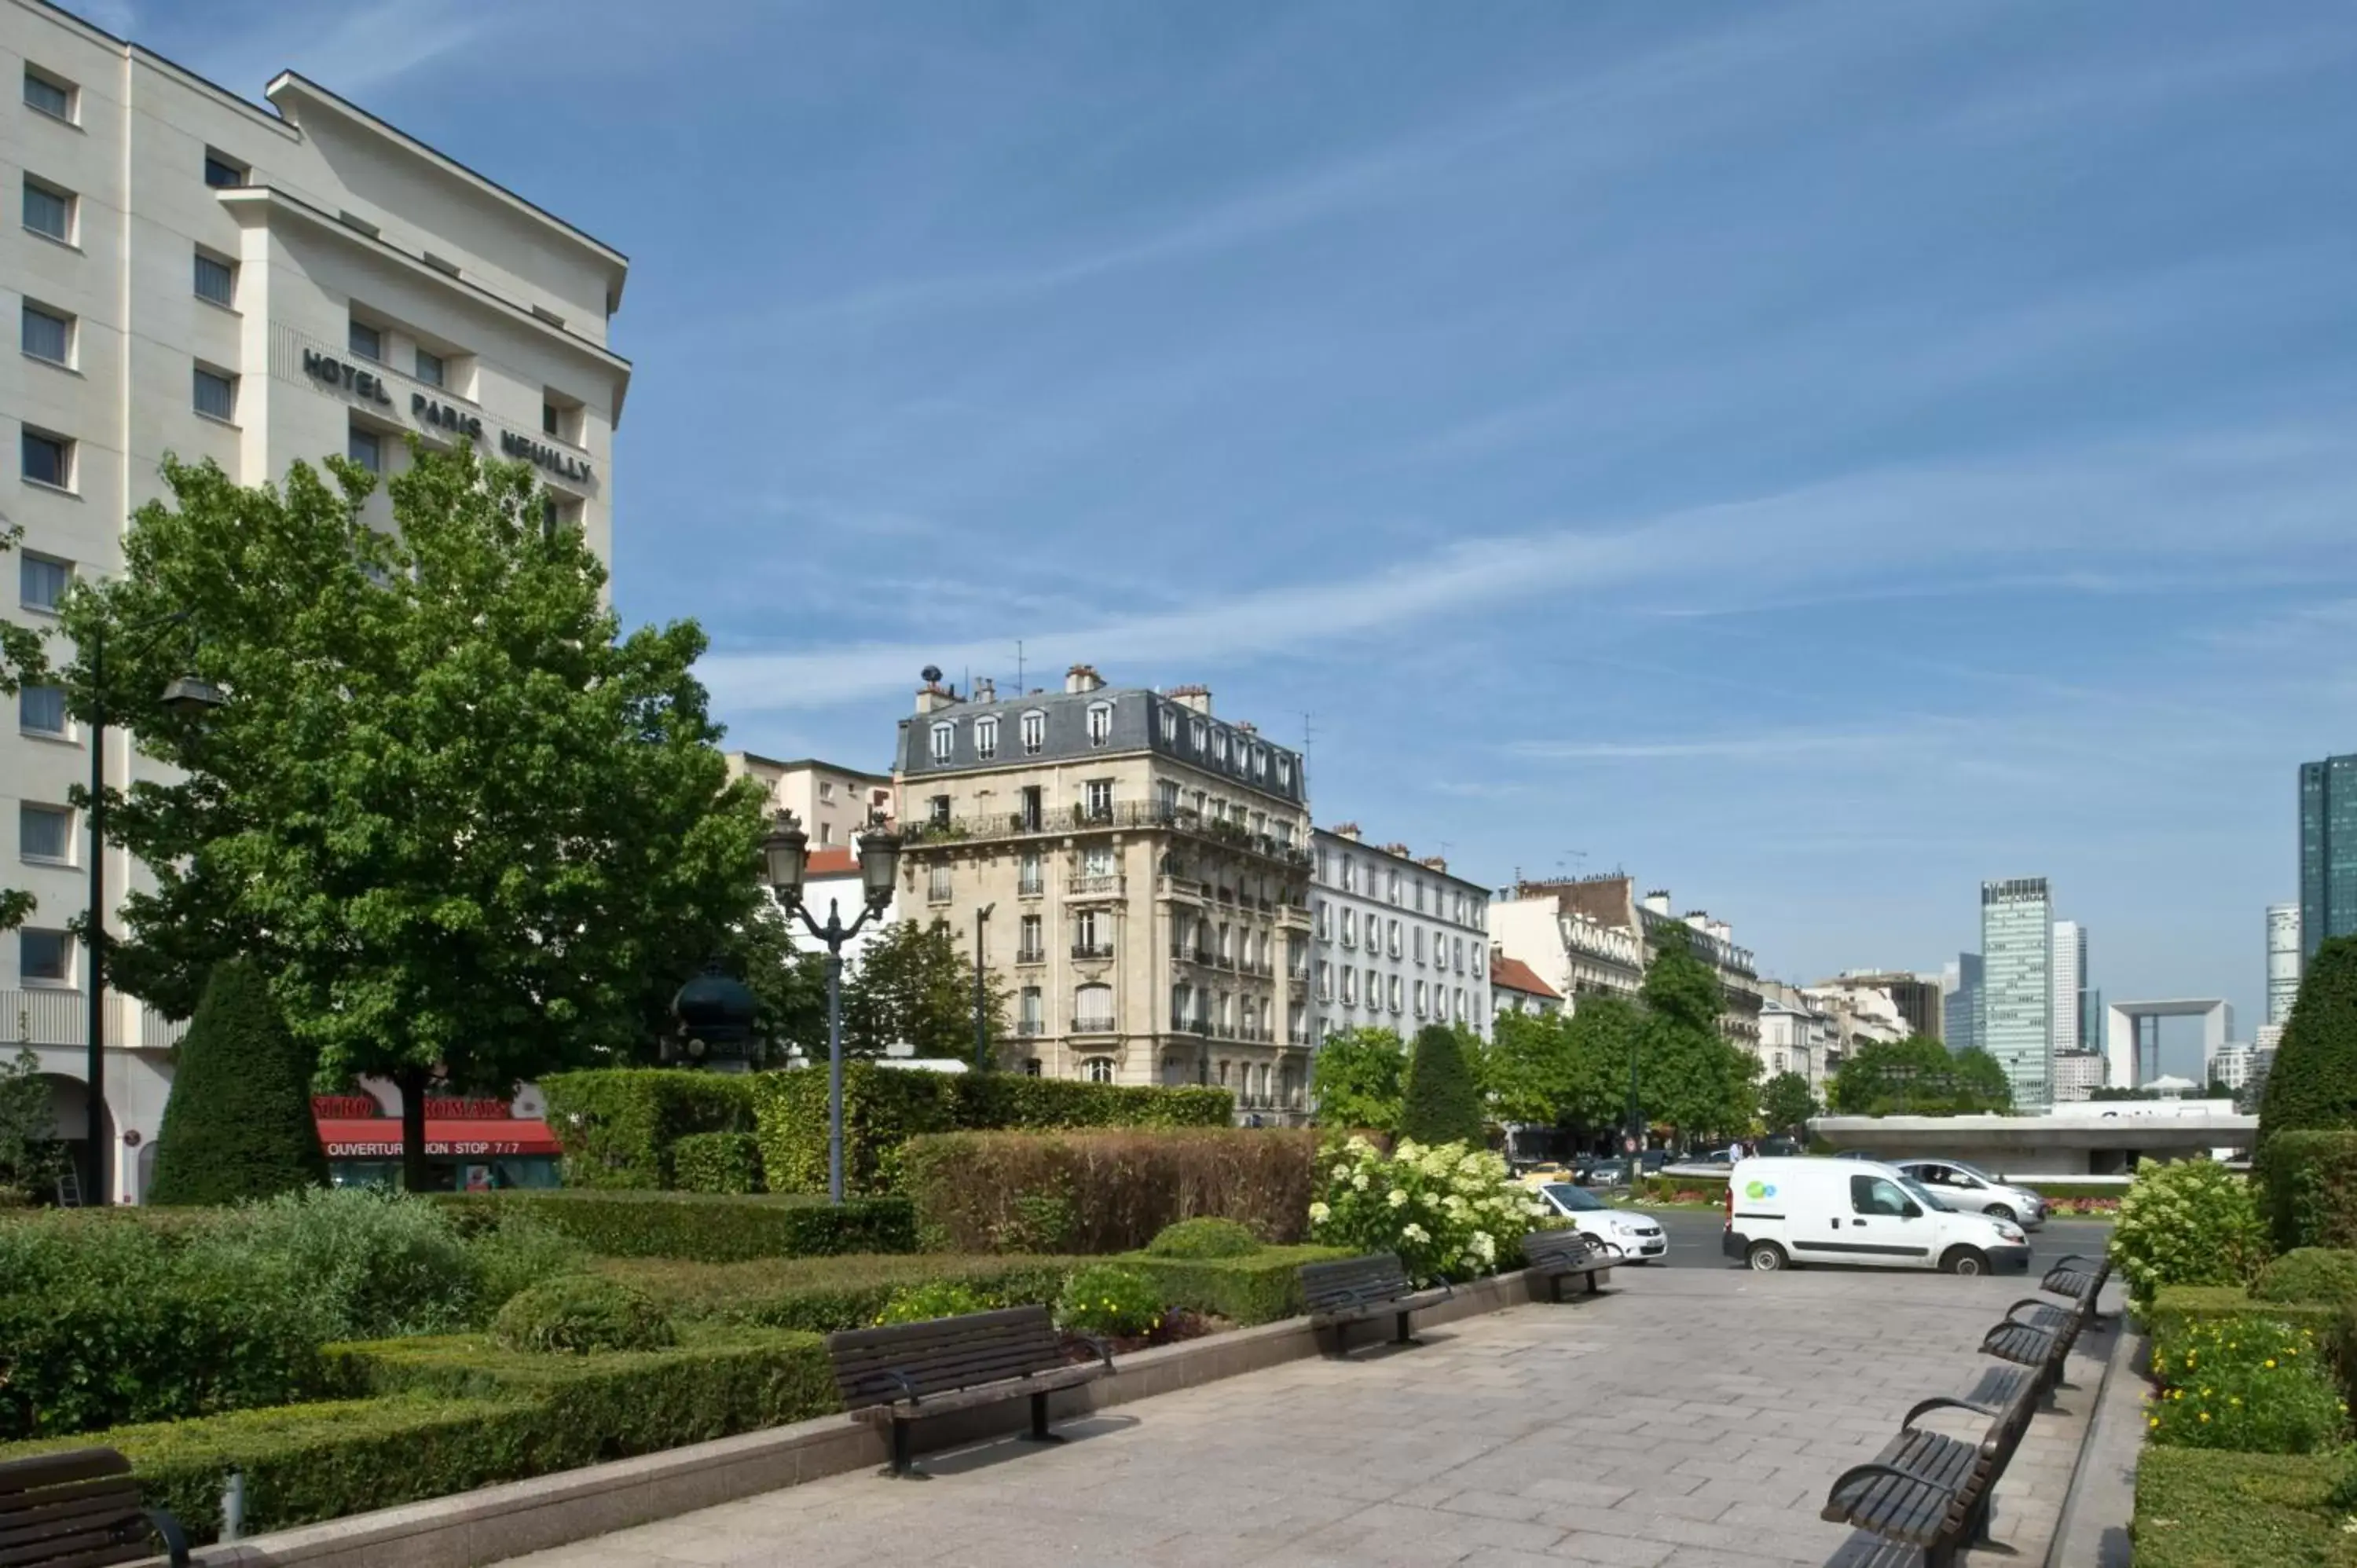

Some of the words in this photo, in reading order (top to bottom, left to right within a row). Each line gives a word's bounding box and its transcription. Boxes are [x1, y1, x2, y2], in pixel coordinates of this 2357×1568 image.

[303, 348, 391, 405] HOTEL
[412, 392, 482, 440] PARIS
[501, 430, 592, 483] NEUILLY
[328, 1143, 403, 1156] OUVERTUR
[455, 1143, 489, 1154] STOP
